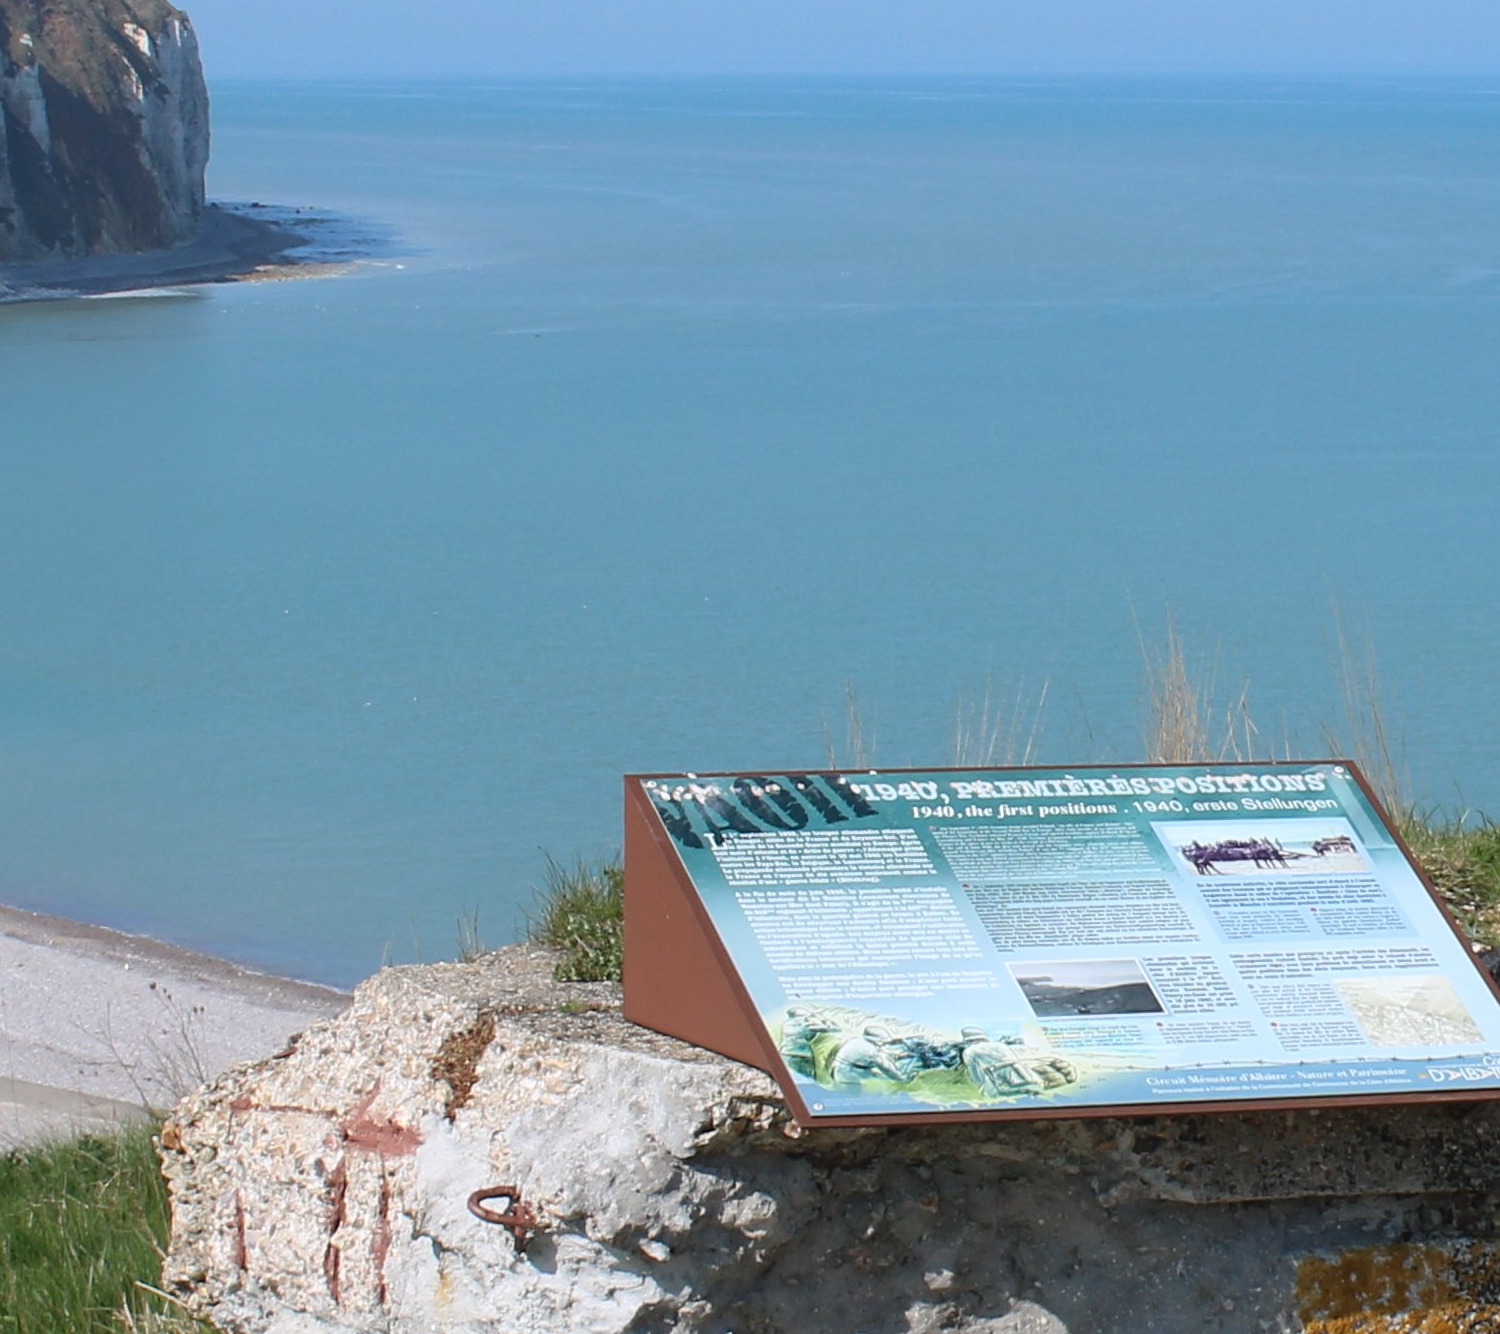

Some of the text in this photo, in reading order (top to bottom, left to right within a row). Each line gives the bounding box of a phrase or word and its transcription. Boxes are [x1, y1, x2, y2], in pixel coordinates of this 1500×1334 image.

[860, 780, 950, 805] 1940,
[1151, 772, 1327, 795] POSITIONS
[911, 805, 963, 820] 1940,
[965, 804, 993, 818] the
[996, 803, 1033, 819] first
[1038, 801, 1118, 818] positions
[1132, 799, 1190, 814] 1940,
[1192, 801, 1238, 812] erste
[1241, 797, 1339, 813] Stellungen
[1146, 1075, 1187, 1086] Circuit
[1188, 1074, 1237, 1085] Mémoire
[1240, 1071, 1287, 1082] d'Albâtre
[1296, 1070, 1335, 1080] Nature
[1337, 1070, 1348, 1078] et
[1349, 1067, 1407, 1078] Patrimoine
